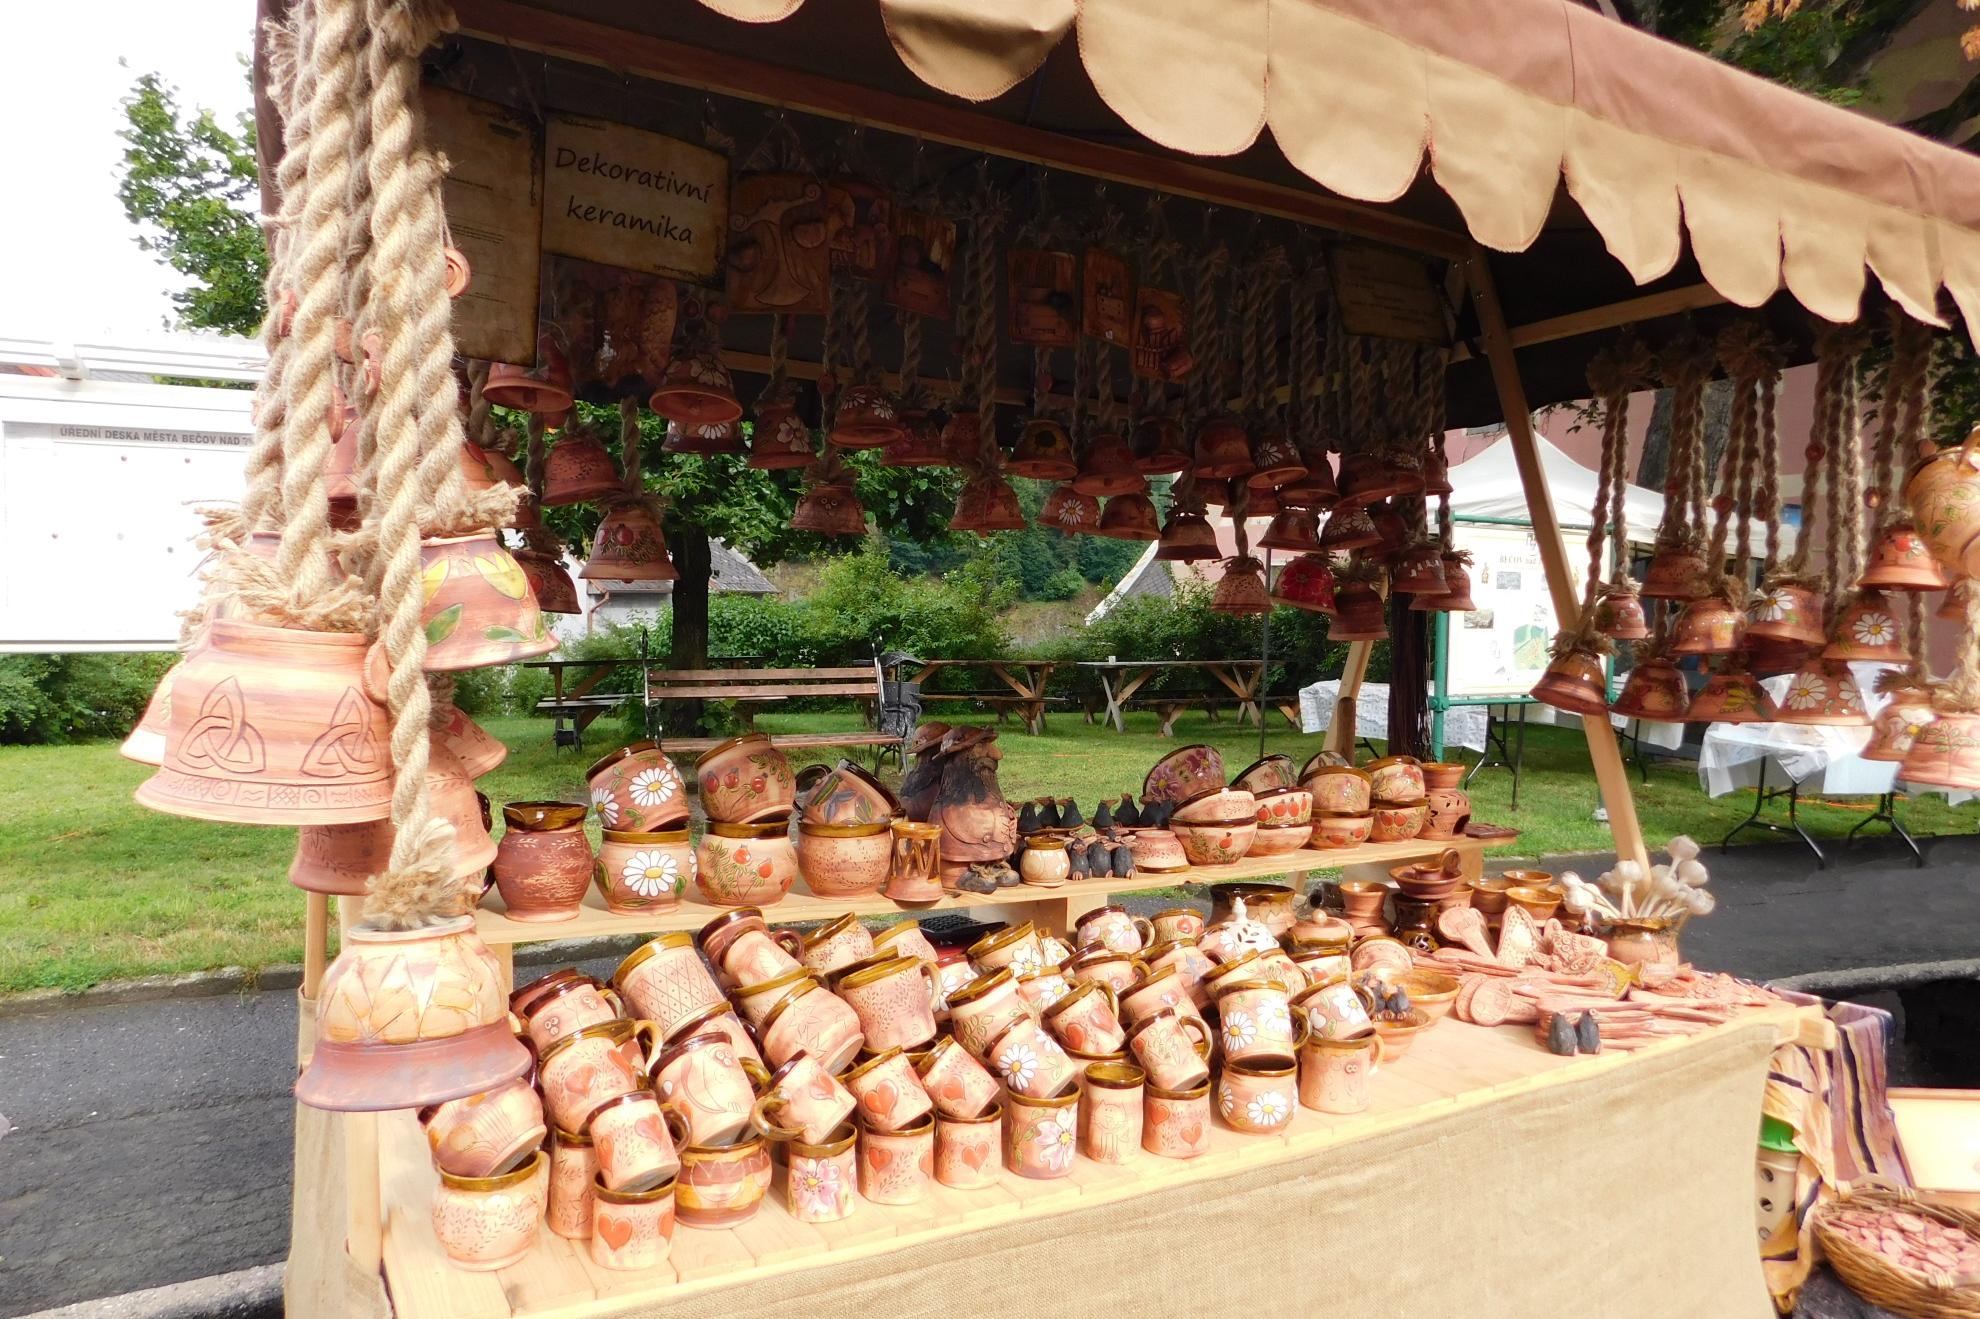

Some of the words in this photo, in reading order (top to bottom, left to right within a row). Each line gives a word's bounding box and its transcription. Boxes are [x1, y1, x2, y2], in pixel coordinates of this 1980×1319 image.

[555, 147, 714, 203] Dekorativní
[566, 195, 692, 244] keramika
[104, 429, 141, 440] DESKA
[143, 430, 178, 443] MĚSTA
[182, 432, 216, 444] BEČOV
[219, 435, 240, 446] NAD
